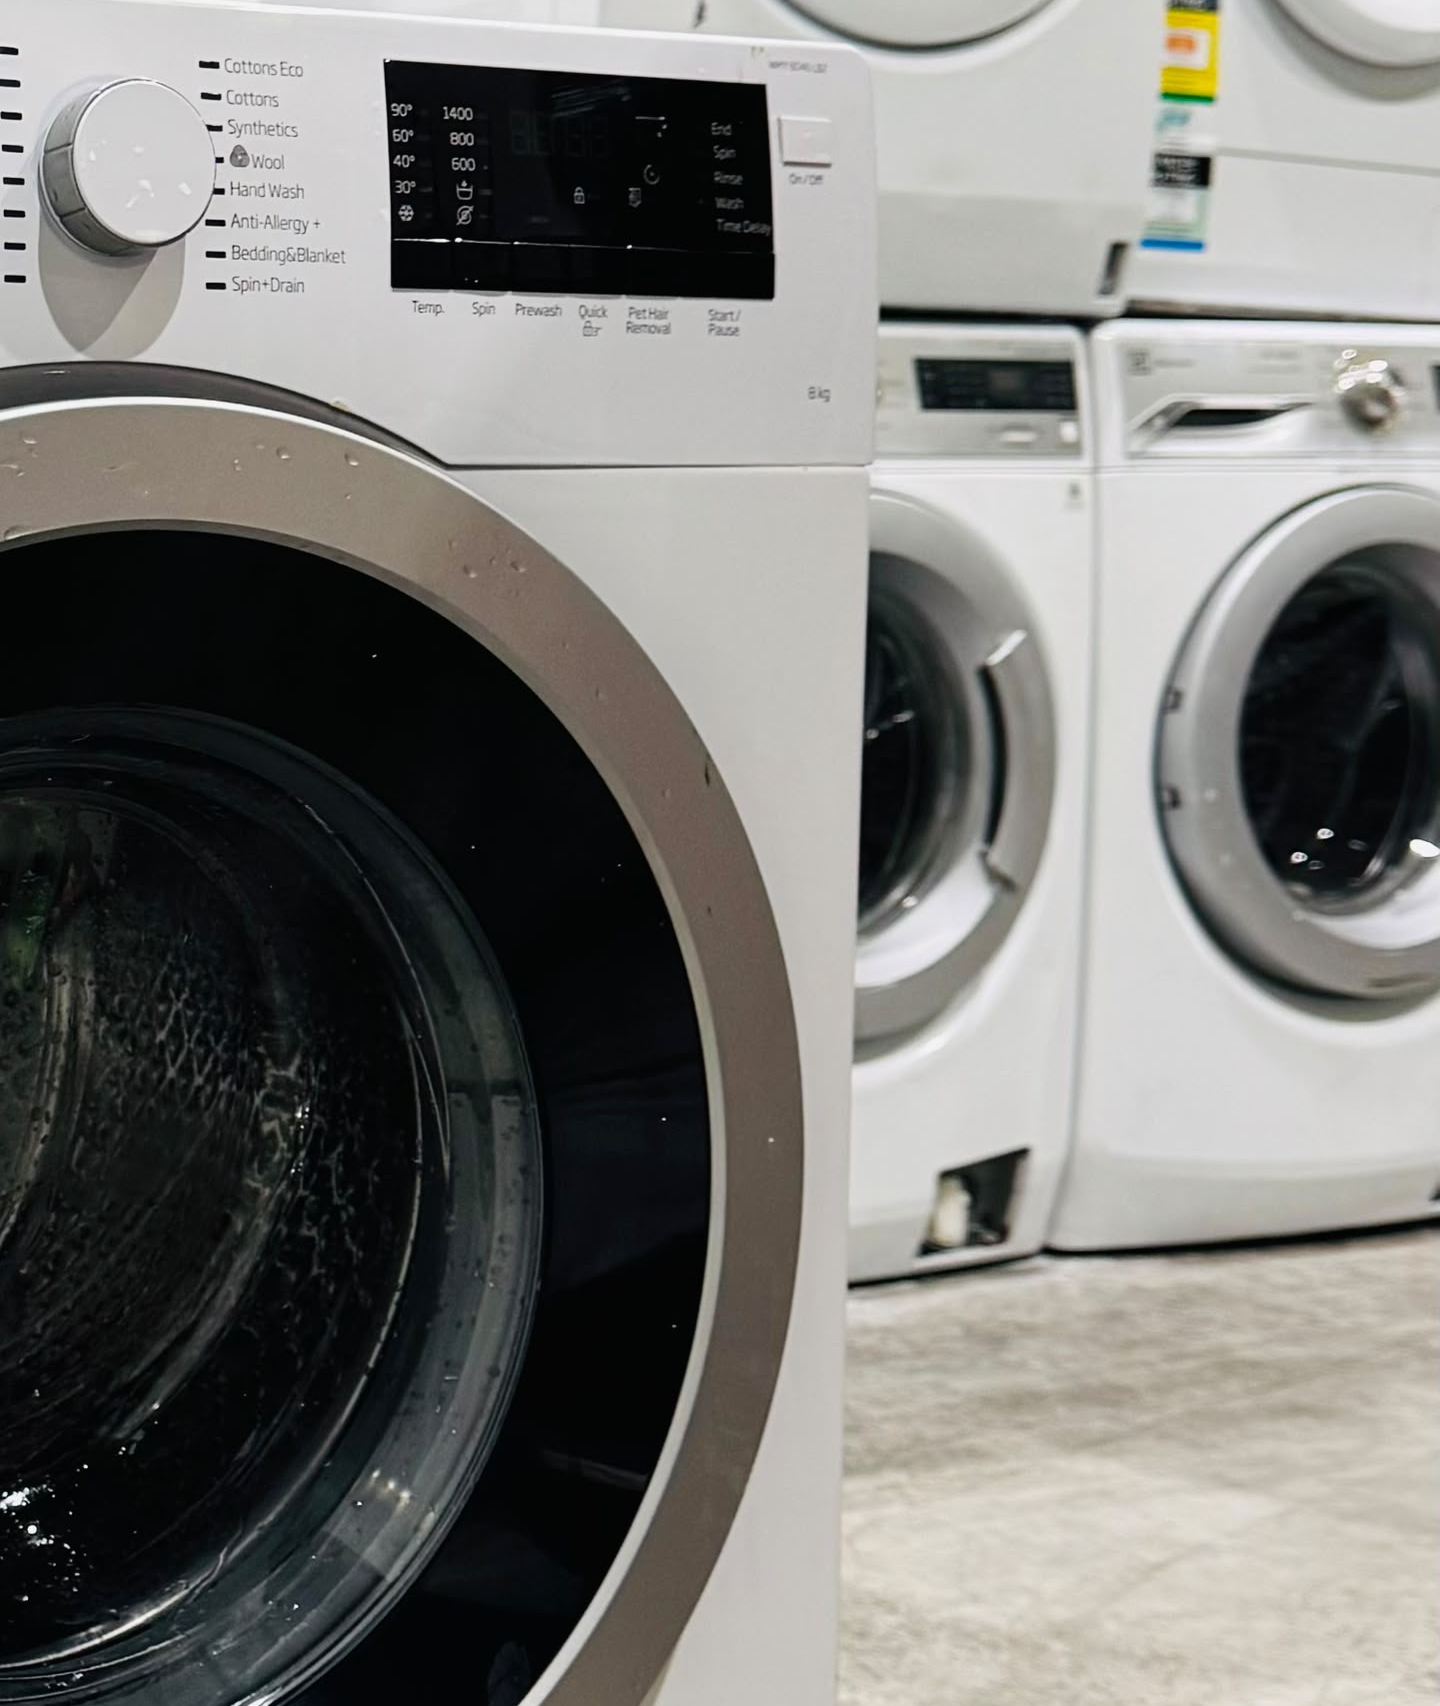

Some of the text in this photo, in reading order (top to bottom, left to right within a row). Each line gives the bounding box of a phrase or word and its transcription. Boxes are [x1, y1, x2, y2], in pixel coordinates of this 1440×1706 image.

[224, 58, 304, 78] Cottons Eco
[226, 90, 280, 108] Cottons
[442, 106, 474, 121] 1400
[227, 119, 299, 139] Synthetics
[450, 132, 474, 146] 800
[251, 154, 285, 170] Wool
[451, 157, 476, 172] 600
[230, 181, 305, 200] Hand Wash
[230, 213, 309, 235] Anti-Allergy
[232, 245, 346, 266] Bedding&Blanket
[232, 276, 305, 295] Spin+Drain
[412, 300, 445, 317] Temp.
[472, 301, 496, 317] Spin
[515, 303, 562, 317] Prewash
[578, 304, 608, 320] Quick
[628, 306, 669, 321] Pet Hair
[626, 321, 672, 335] Removal
[708, 323, 740, 337] Pause
